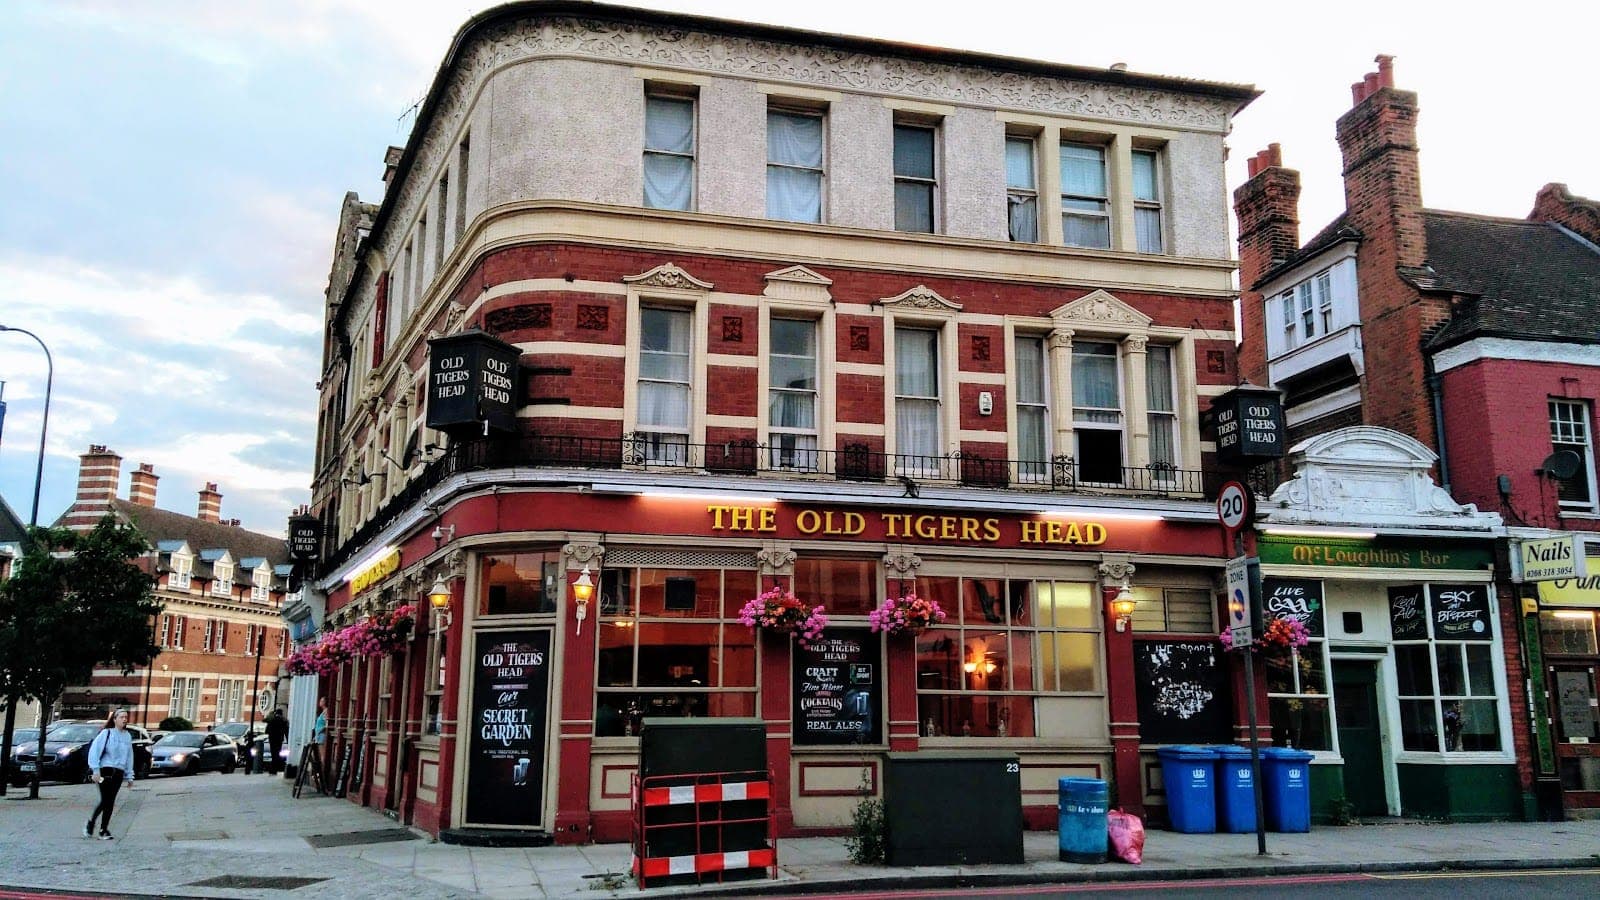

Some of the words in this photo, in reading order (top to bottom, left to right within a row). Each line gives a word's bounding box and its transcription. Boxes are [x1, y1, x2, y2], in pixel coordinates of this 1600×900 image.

[441, 357, 464, 370] OLD
[487, 359, 507, 374] OLD
[435, 370, 470, 385] TIGERS
[482, 370, 512, 390] TIGERS
[438, 385, 466, 399] HEAD
[484, 386, 510, 404] HEAD
[1218, 409, 1233, 422] OLD
[1248, 406, 1270, 417] OLD
[1217, 421, 1238, 436] TIGERS
[1243, 418, 1277, 431] TIGERS
[1221, 433, 1238, 448] HEAD
[1249, 431, 1276, 443] HEAD
[1221, 494, 1243, 519] 20
[707, 505, 777, 532] THE
[796, 509, 866, 535] OLD
[881, 513, 1000, 541] TIGERS
[1020, 519, 1108, 546] HEAD
[1420, 550, 1450, 565] Bar
[1526, 541, 1571, 563] Nails
[1543, 568, 1555, 577] 318
[1274, 587, 1304, 596] LIVE
[1440, 591, 1475, 604] SKY
[503, 643, 518, 652] THE
[482, 654, 503, 667] OLD
[507, 652, 543, 666] TIGERS
[498, 668, 522, 677] HEAD
[806, 667, 839, 681] CRAFT
[482, 708, 528, 724] SECRET
[807, 721, 832, 730] REAL
[836, 721, 863, 730] ALES
[481, 724, 532, 746] GARDEN
[1006, 763, 1019, 773] 23
